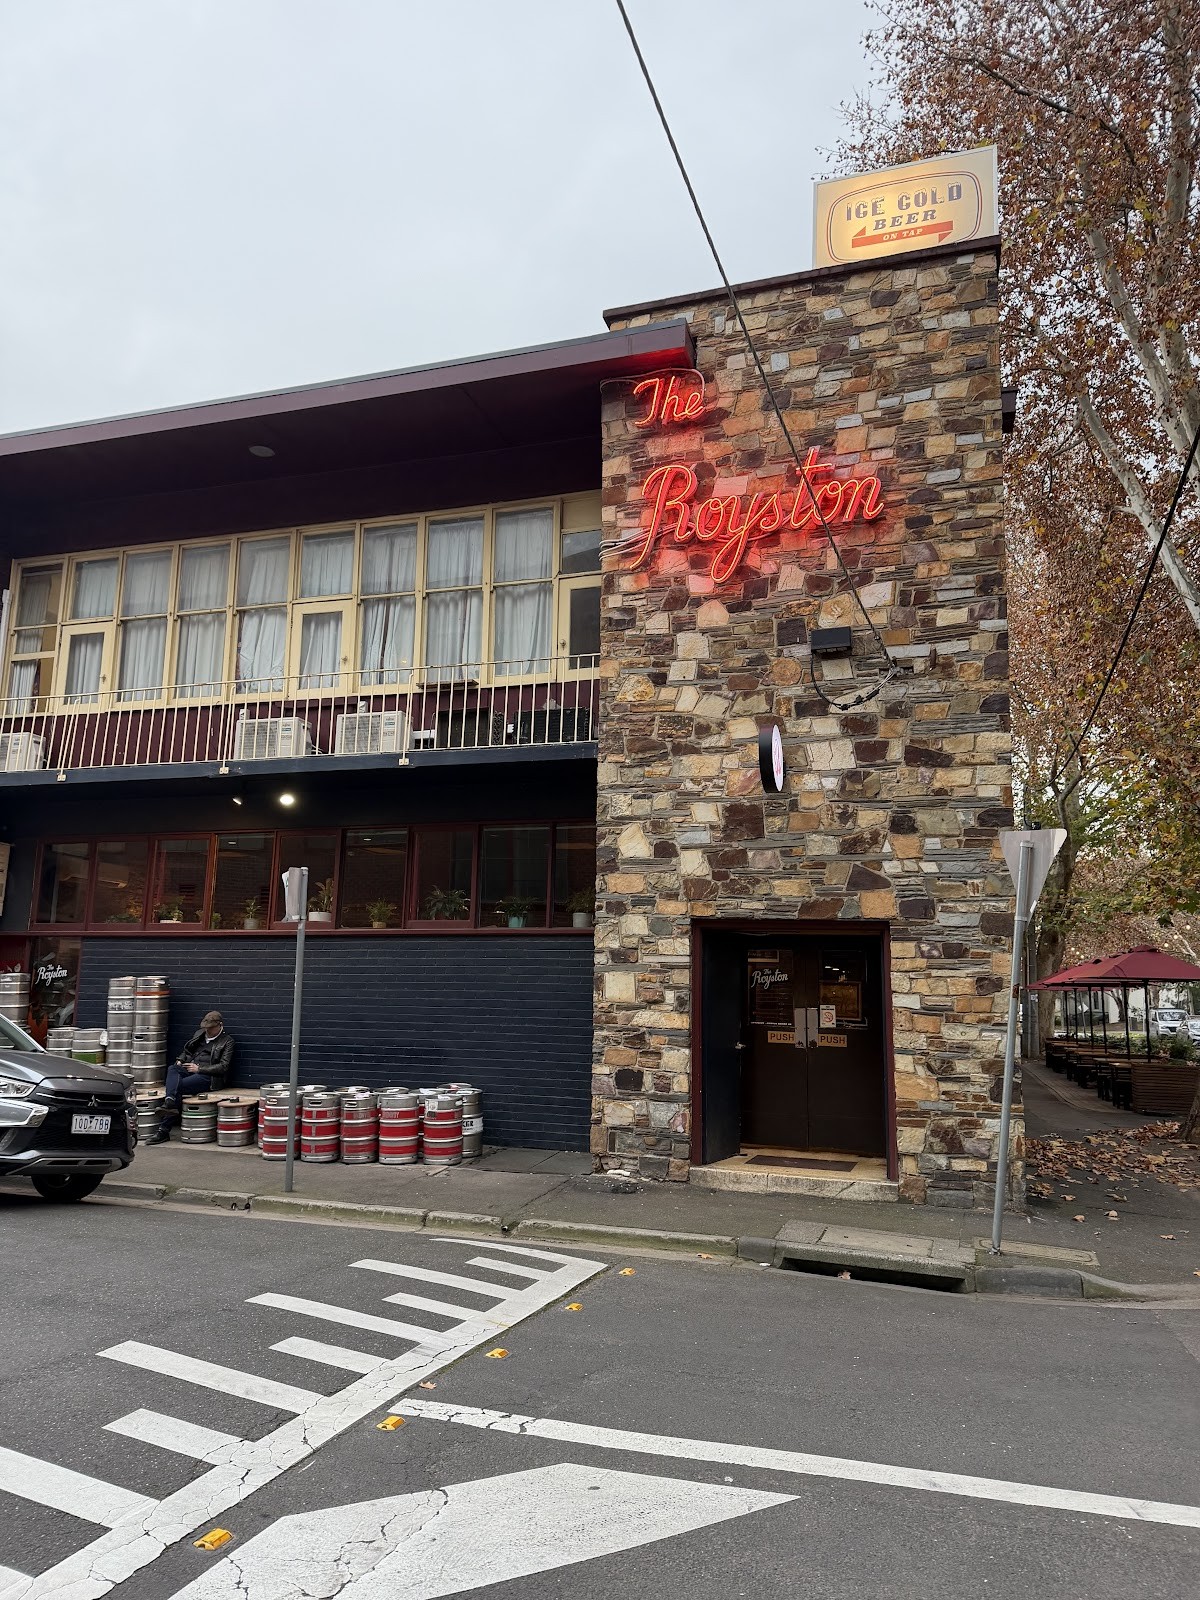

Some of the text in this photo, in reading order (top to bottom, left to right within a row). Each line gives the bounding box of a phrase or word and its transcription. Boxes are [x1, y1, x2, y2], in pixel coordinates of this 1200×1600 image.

[846, 182, 962, 221] ICE COLD
[873, 208, 937, 231] BEER
[882, 228, 924, 241] ON TAP
[633, 375, 705, 426] The
[630, 446, 884, 583] Royston
[35, 964, 68, 987] Royston
[750, 968, 789, 990] Royston
[770, 1032, 795, 1042] PUSH
[820, 1035, 846, 1045] PUSH
